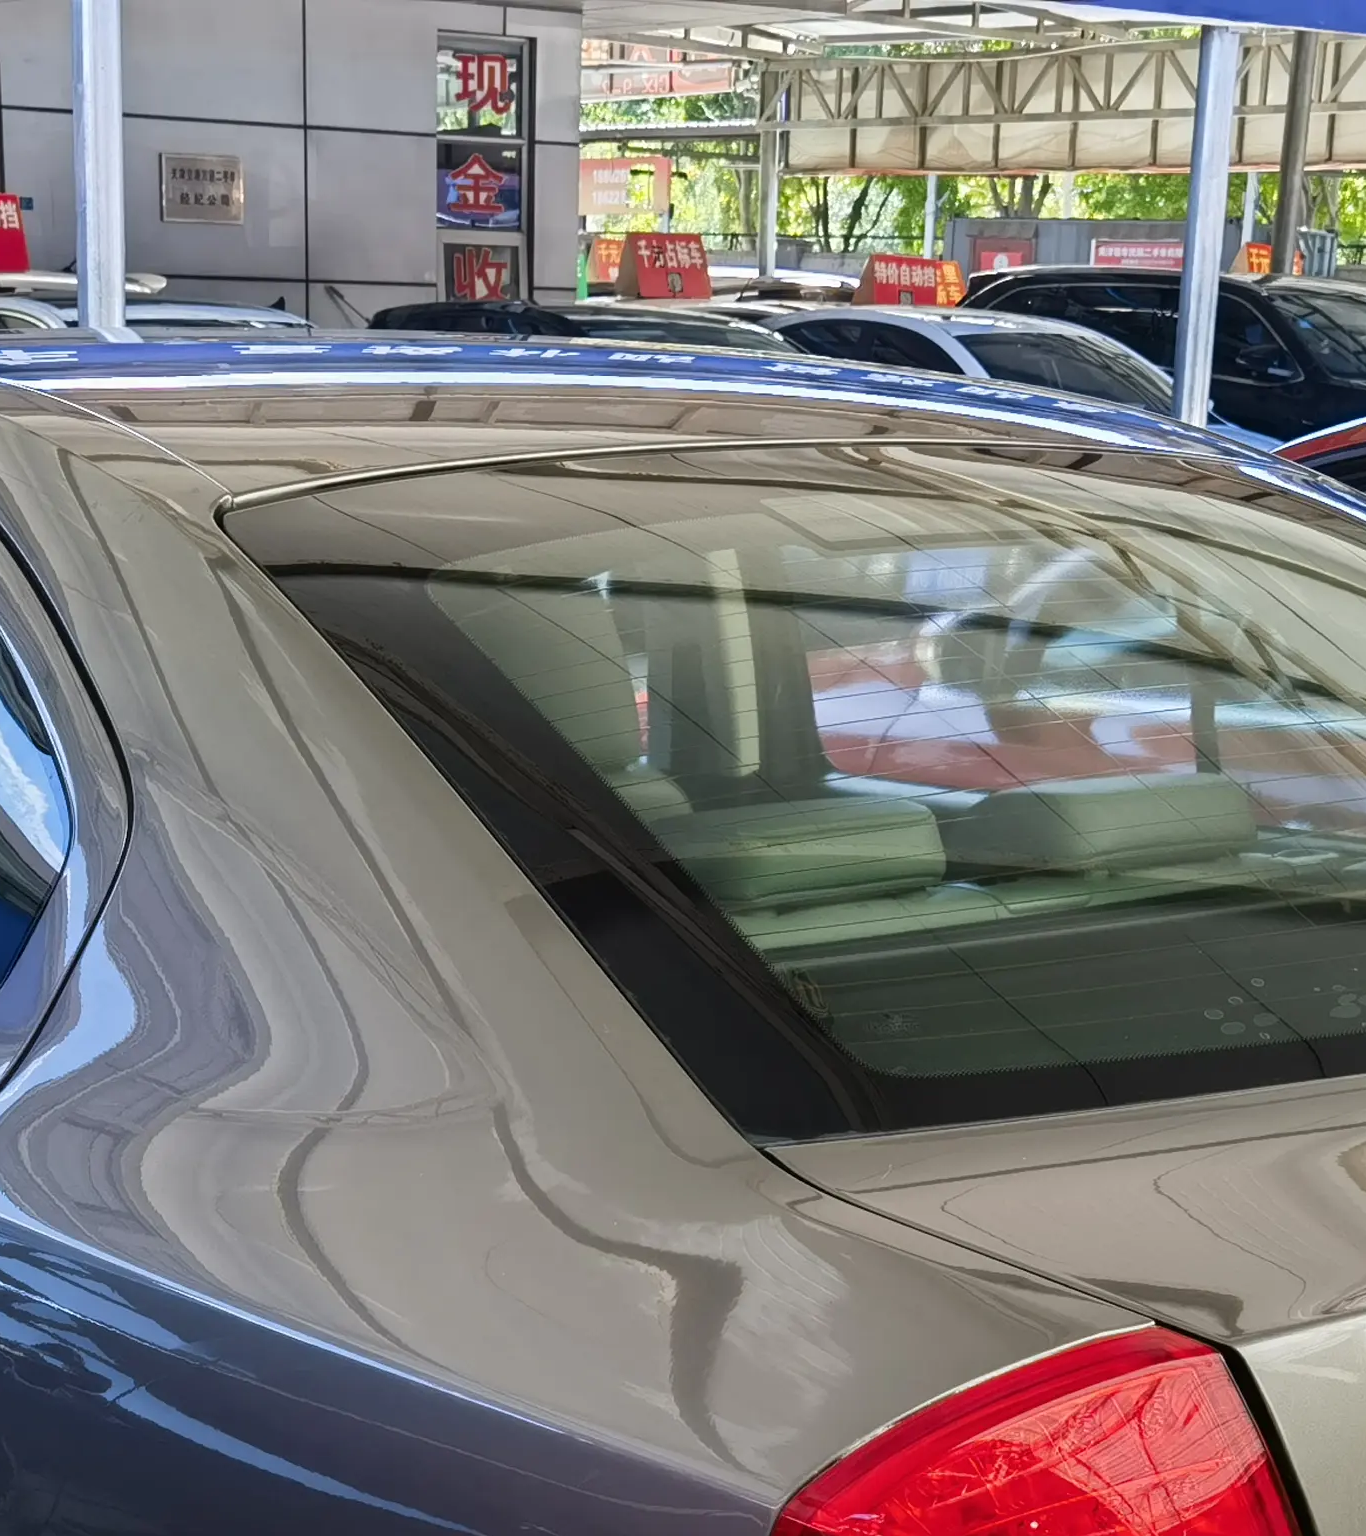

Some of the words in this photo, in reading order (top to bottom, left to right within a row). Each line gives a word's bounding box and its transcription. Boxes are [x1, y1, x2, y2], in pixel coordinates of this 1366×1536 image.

[874, 261, 936, 288] 特价自动挡
